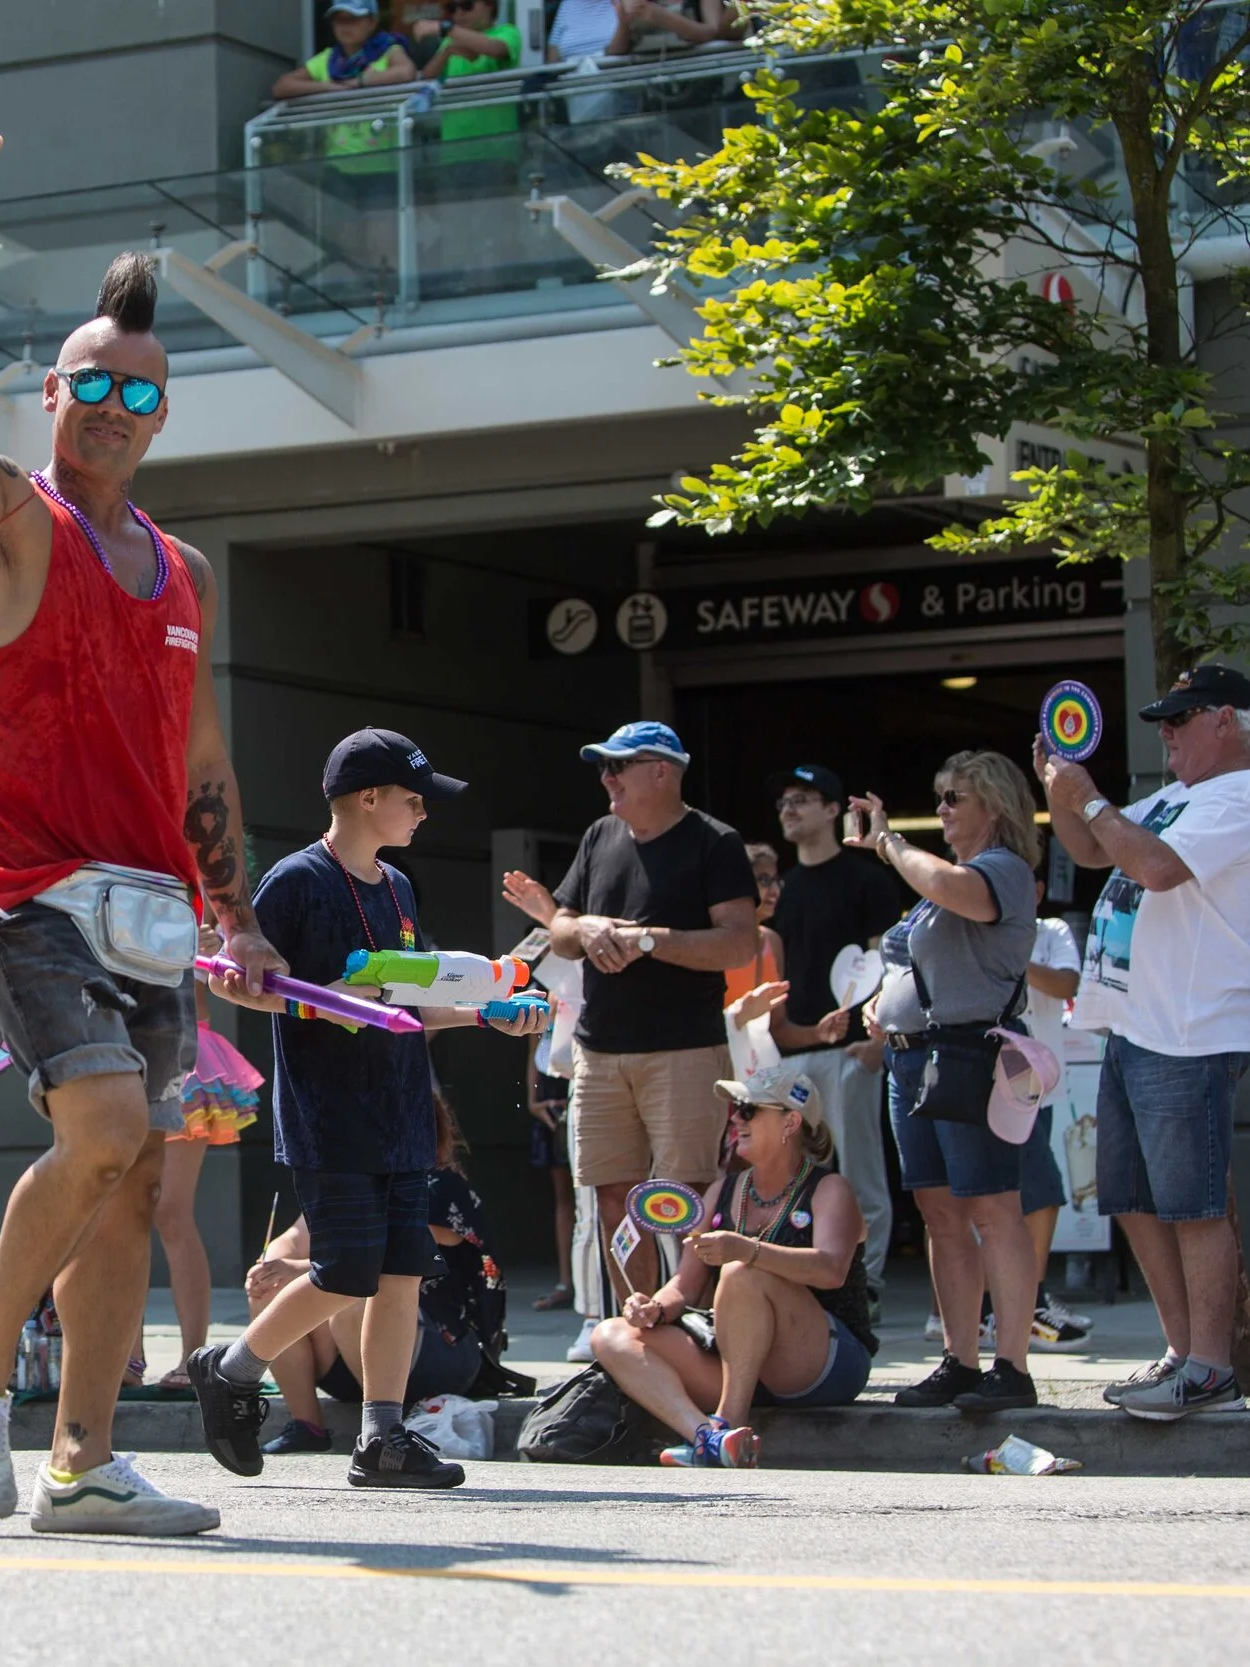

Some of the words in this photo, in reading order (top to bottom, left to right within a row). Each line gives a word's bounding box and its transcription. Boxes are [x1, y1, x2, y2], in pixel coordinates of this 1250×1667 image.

[696, 589, 855, 633] SAFEWAY
[920, 584, 945, 617] &
[957, 576, 1086, 614] Parking
